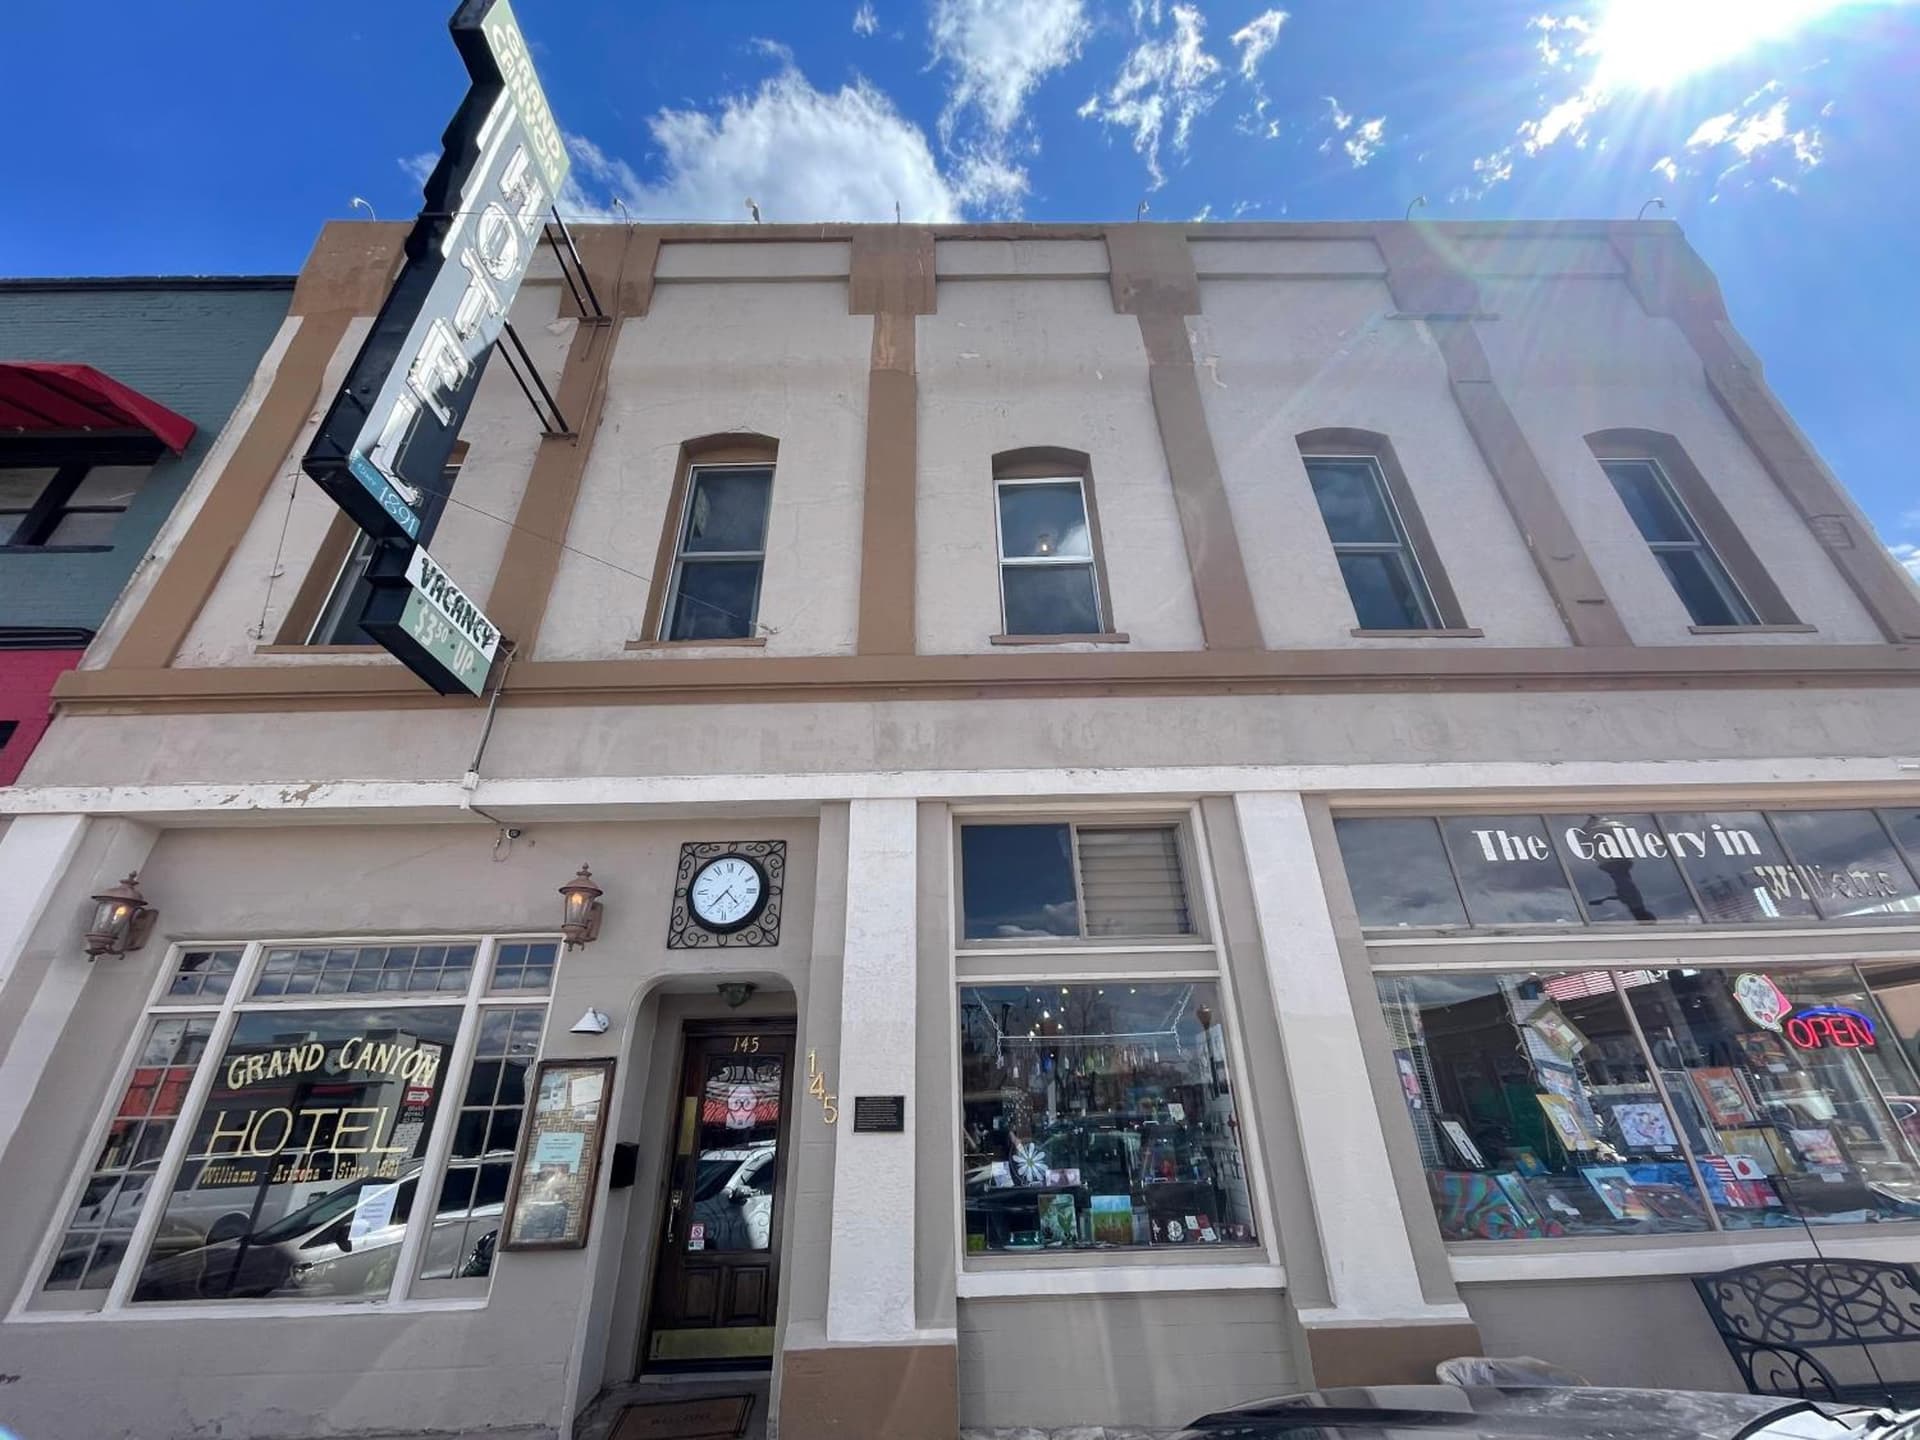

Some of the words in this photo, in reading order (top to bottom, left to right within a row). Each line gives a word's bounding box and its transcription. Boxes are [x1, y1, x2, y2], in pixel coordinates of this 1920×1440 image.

[492, 23, 560, 185] CANYON
[506, 23, 561, 160] GRAND
[369, 143, 544, 507] HOTEL
[379, 486, 417, 534] 1891
[421, 557, 495, 650] VACANCY
[453, 639, 475, 677] UP
[1472, 830, 1549, 862] The
[1565, 827, 1706, 862] Gallery
[1711, 823, 1762, 856] in
[733, 1036, 760, 1053] 145
[1787, 1016, 1876, 1049] OPEN
[227, 1043, 325, 1090] GRAND
[339, 1037, 440, 1087] CANYON
[808, 1049, 839, 1124] 145
[205, 1107, 408, 1157] HOTEL
[201, 1165, 258, 1184] Williams
[337, 1161, 369, 1180] Since
